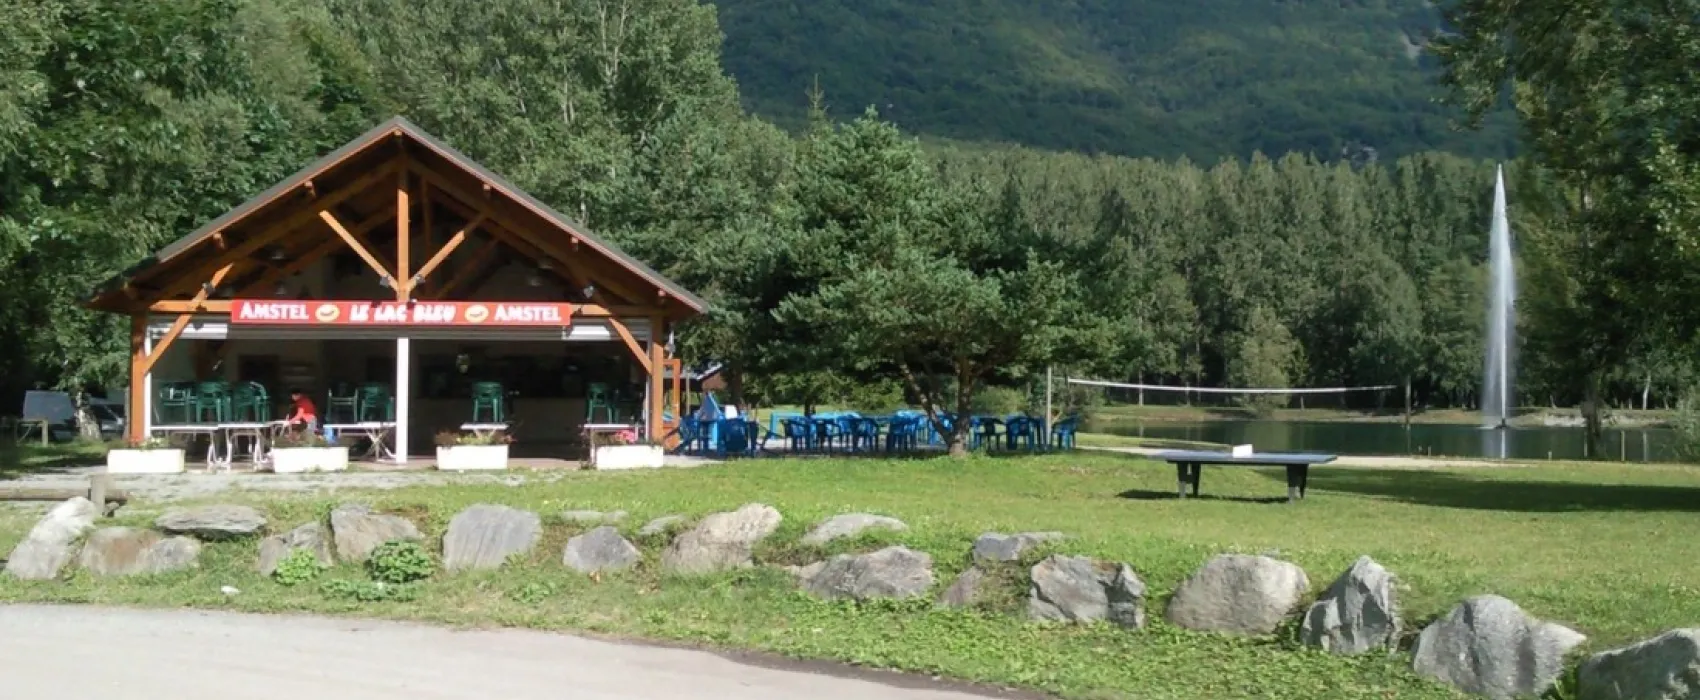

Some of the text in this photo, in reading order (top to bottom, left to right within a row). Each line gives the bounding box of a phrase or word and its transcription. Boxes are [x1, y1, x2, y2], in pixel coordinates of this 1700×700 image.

[239, 301, 562, 323] AMSTEL LE LAC BLEU AMSTEL
